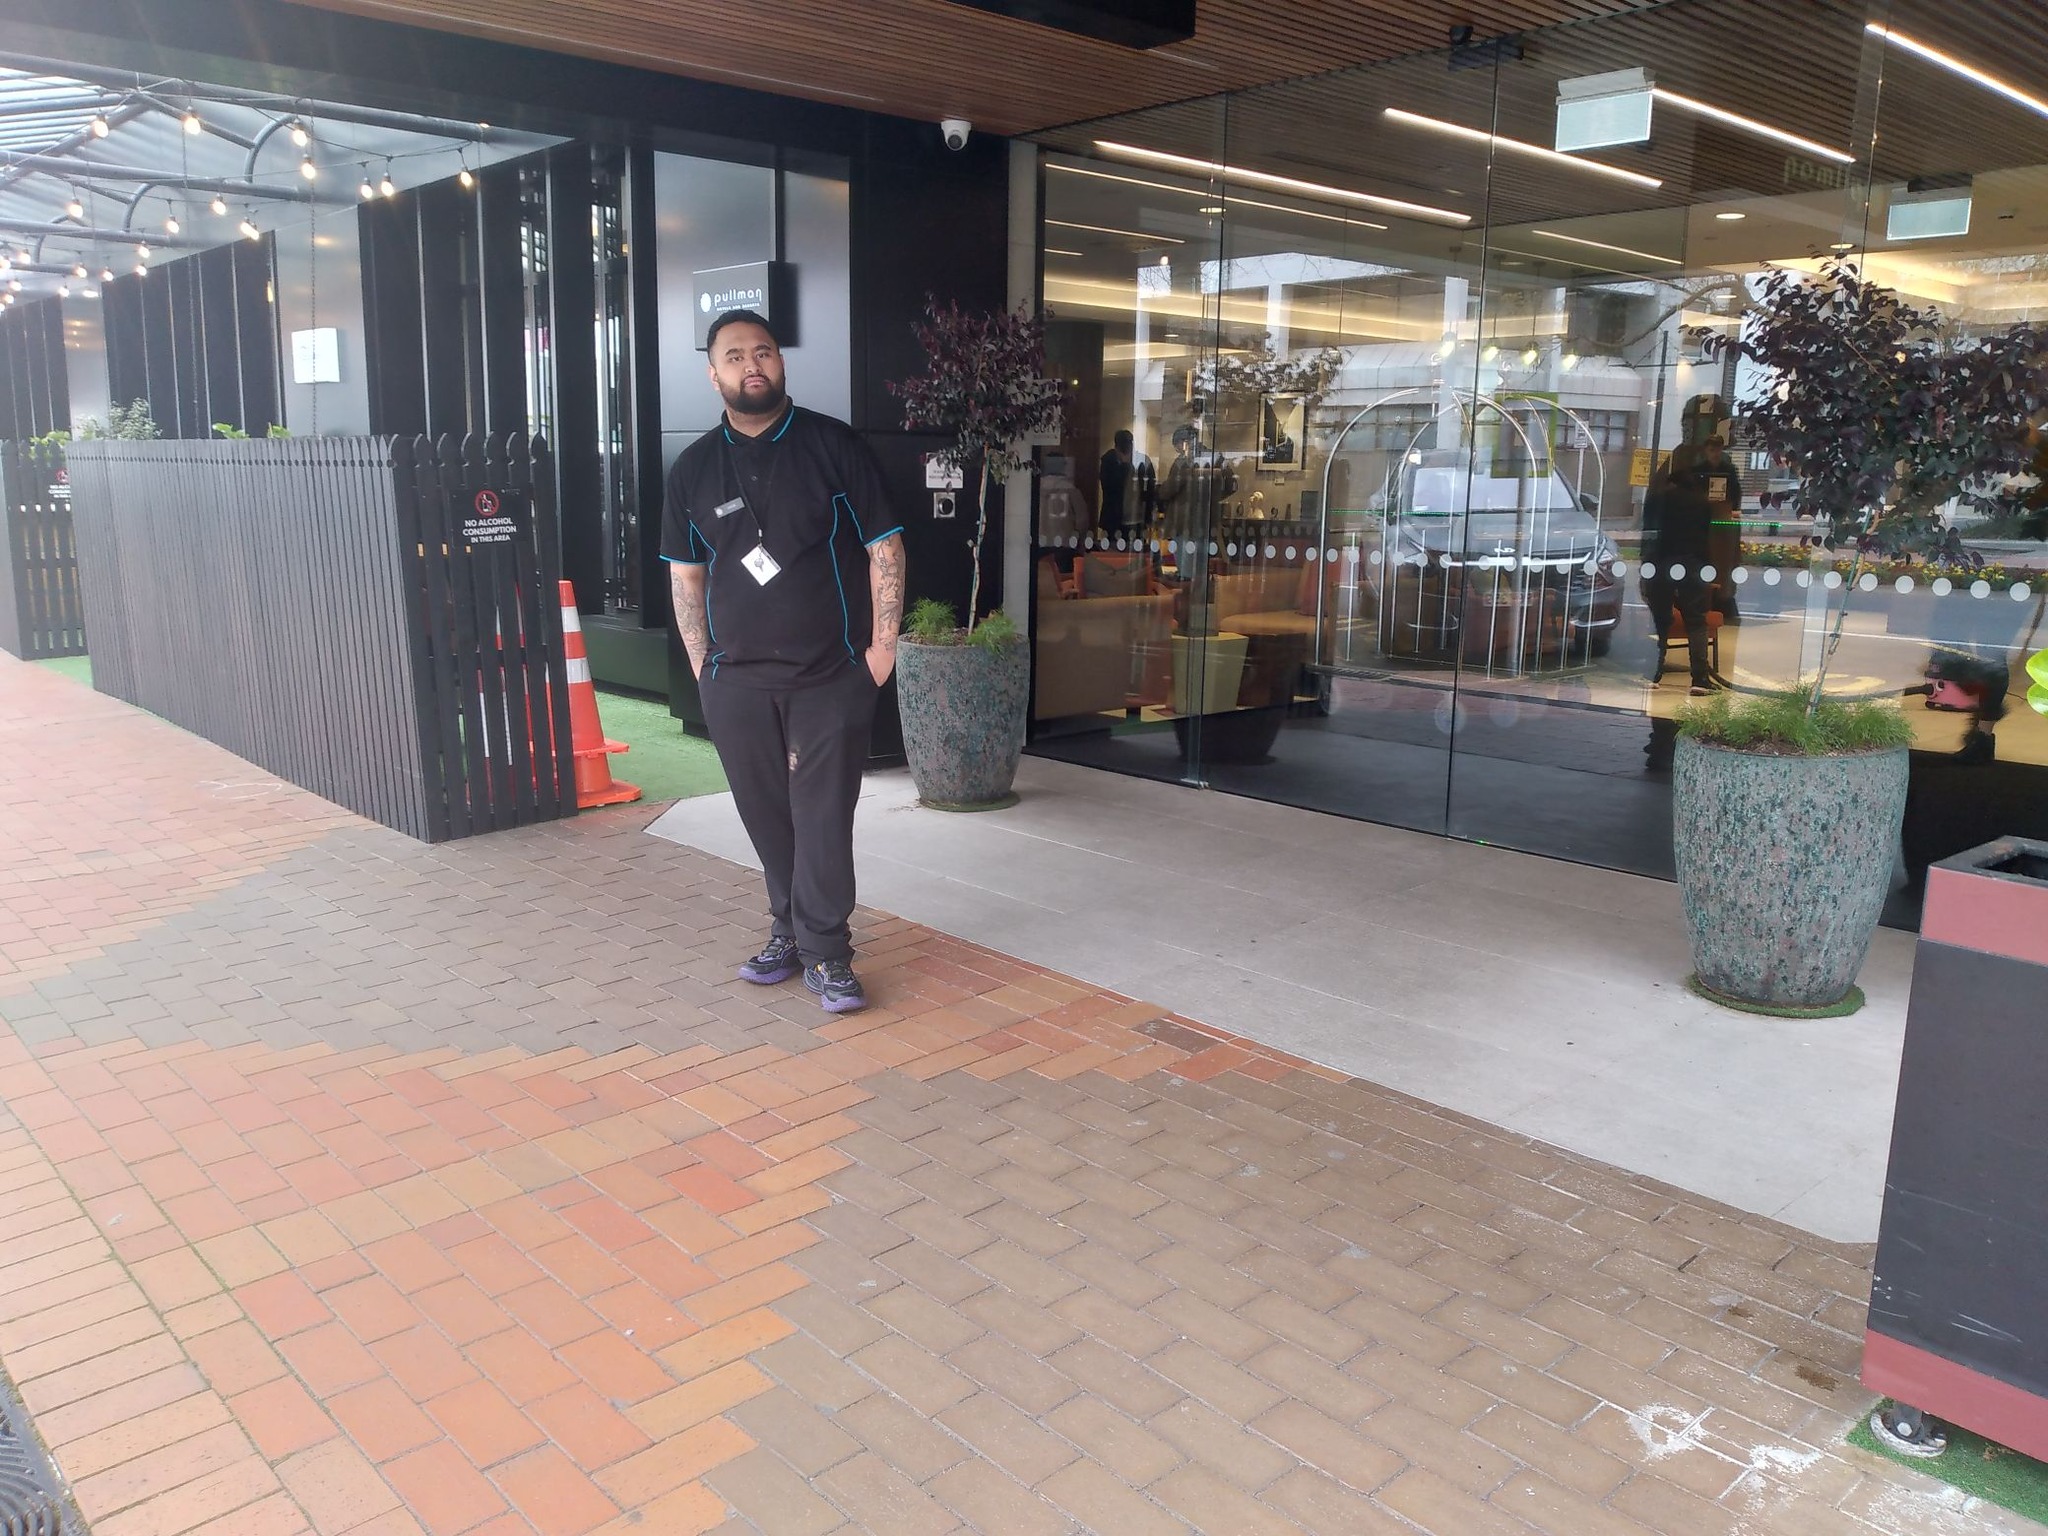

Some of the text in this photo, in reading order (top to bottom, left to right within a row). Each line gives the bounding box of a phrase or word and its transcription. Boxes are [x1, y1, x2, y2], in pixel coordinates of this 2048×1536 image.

[714, 288, 762, 307] pullman
[464, 517, 513, 527] NO ALCOHOL
[462, 525, 517, 536] CONSUMPTION
[479, 535, 493, 543] THIS
[493, 534, 511, 542] AREA
